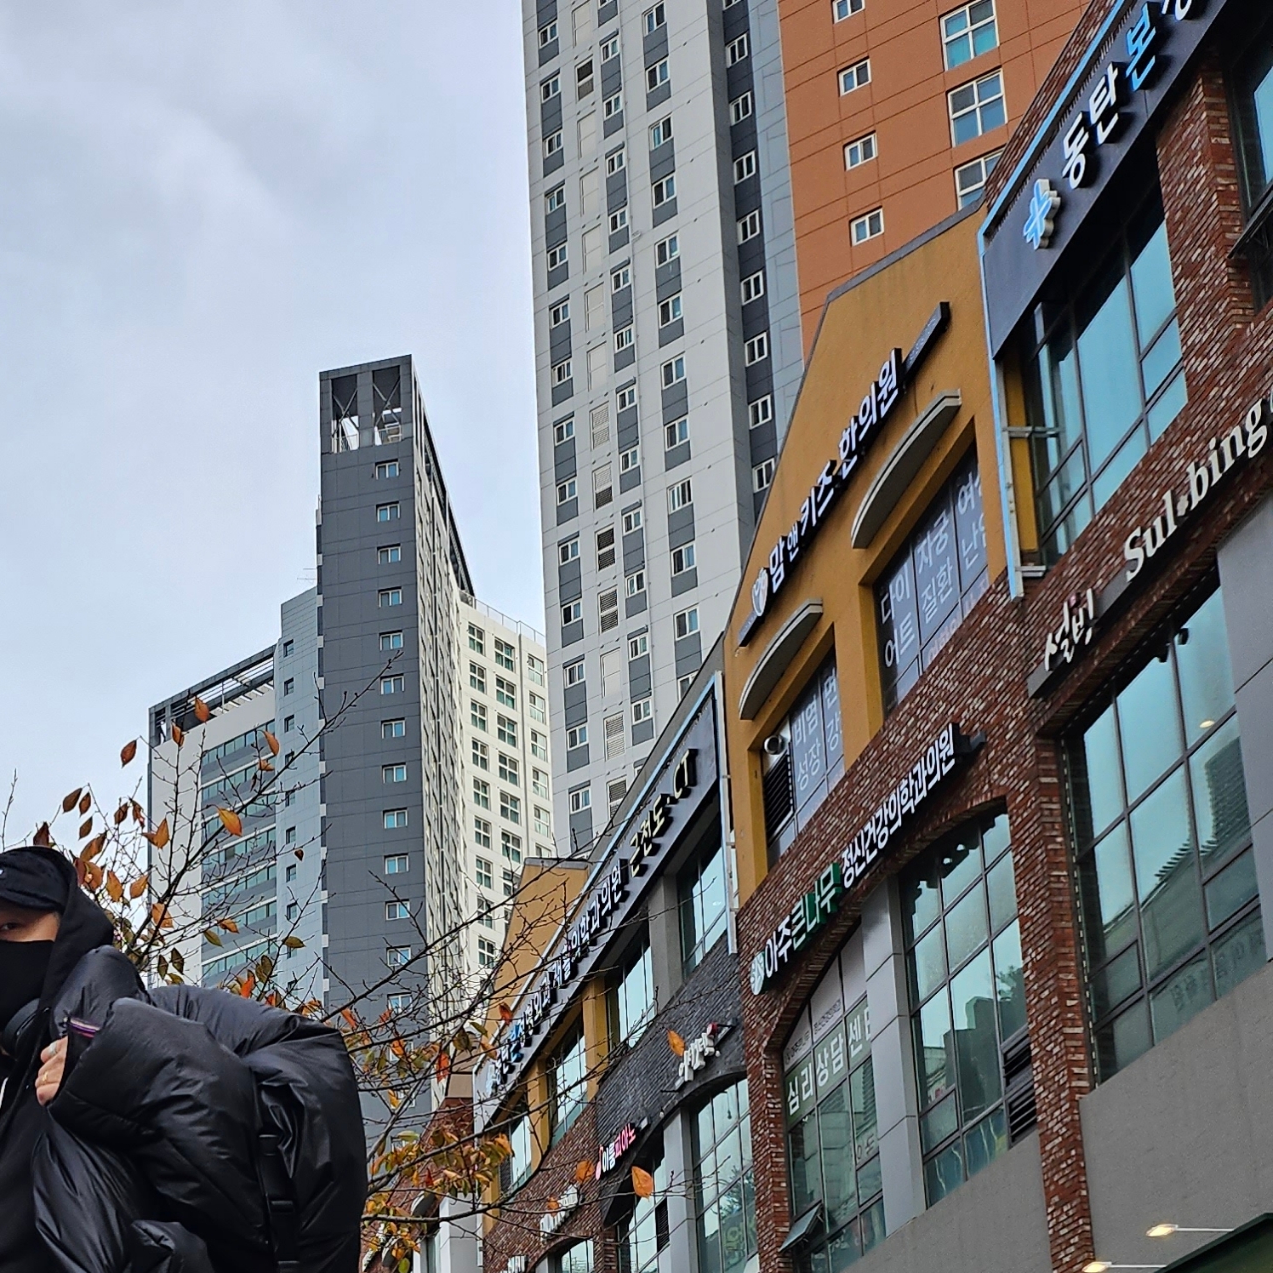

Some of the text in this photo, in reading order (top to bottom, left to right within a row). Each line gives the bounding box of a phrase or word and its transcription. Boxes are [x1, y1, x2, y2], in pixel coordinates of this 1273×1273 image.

[838, 348, 899, 480] 한의원
[917, 509, 949, 574] 자궁
[921, 556, 953, 625] 질환
[796, 738, 822, 792] 성장
